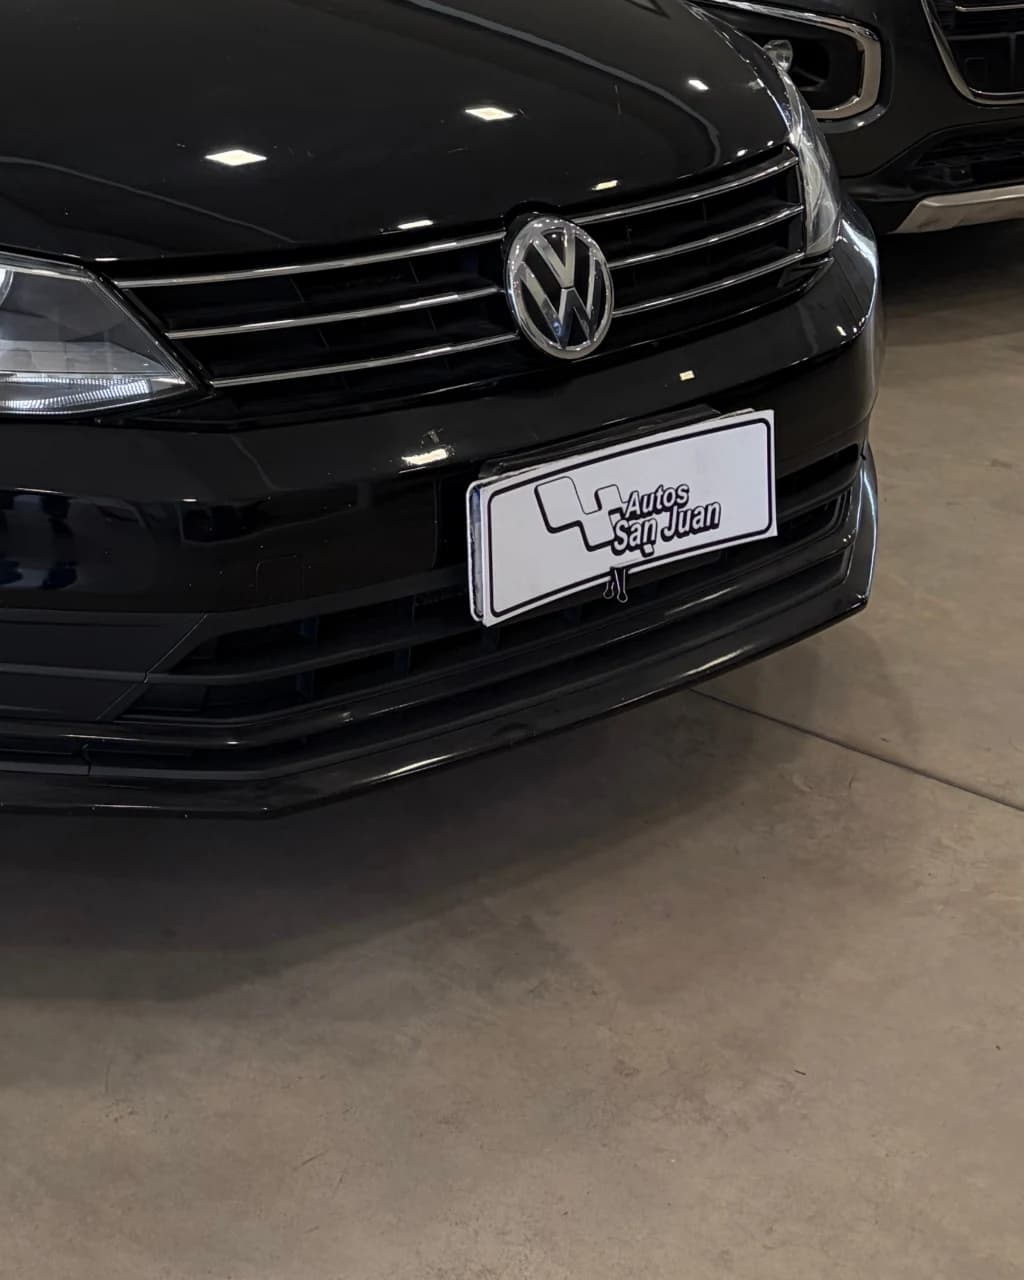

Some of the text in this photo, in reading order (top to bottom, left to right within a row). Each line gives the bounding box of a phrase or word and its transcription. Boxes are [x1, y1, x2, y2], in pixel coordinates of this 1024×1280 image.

[625, 484, 689, 520] Autos
[612, 502, 721, 556] San Juan
